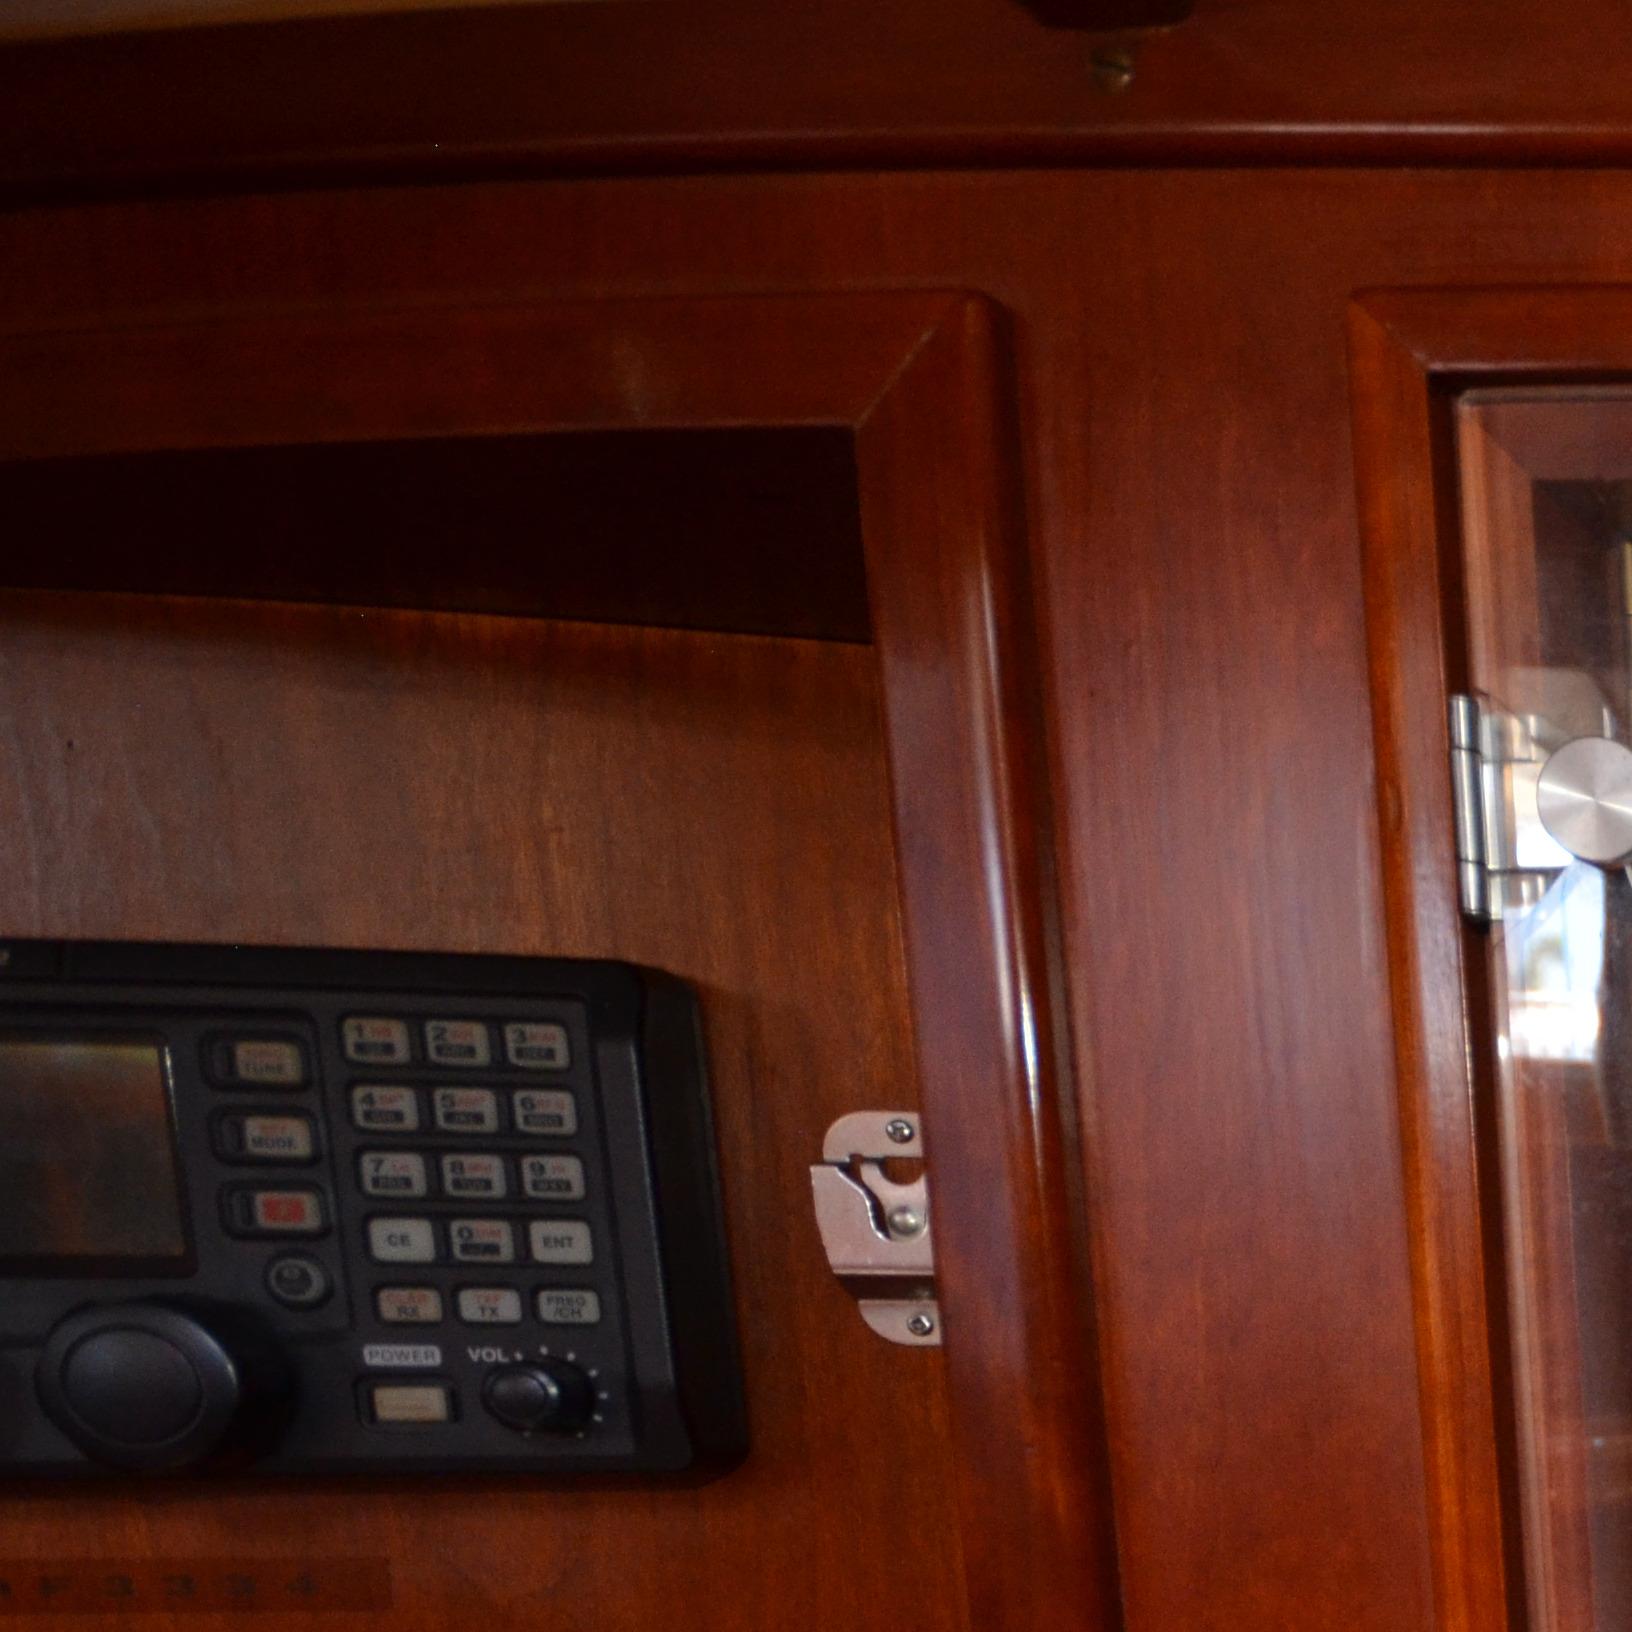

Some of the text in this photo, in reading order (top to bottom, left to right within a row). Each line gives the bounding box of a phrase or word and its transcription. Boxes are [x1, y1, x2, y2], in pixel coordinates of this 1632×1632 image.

[543, 1235, 573, 1248] ENT
[368, 1348, 438, 1364] POWER
[469, 1346, 511, 1364] VOL
